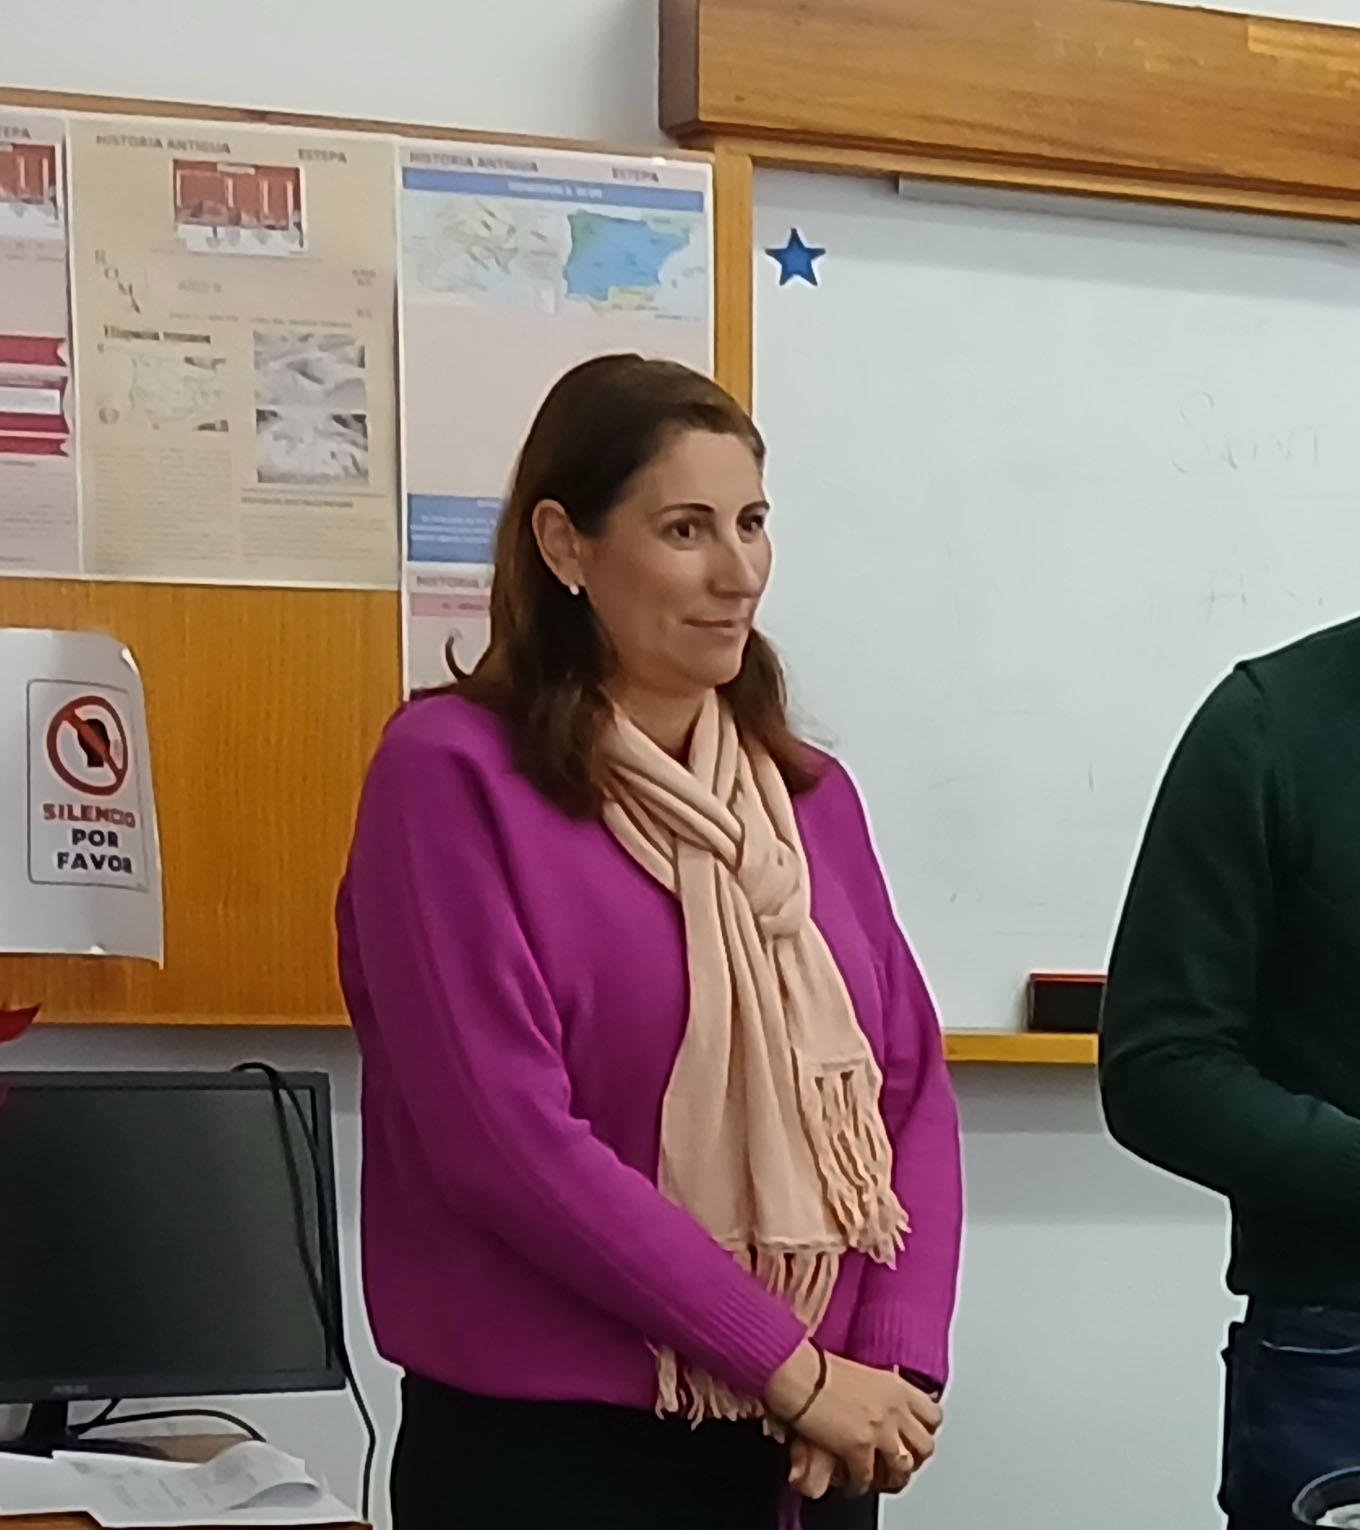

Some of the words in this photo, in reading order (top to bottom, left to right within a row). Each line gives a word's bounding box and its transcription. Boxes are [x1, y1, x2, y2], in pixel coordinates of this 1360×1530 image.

[96, 134, 163, 150] HISTORIA
[166, 139, 231, 154] ANTIGUA
[409, 152, 474, 168] HISTORIA
[42, 802, 136, 829] SILENCIO
[70, 828, 119, 849] POR
[56, 851, 133, 875] FAVOR
